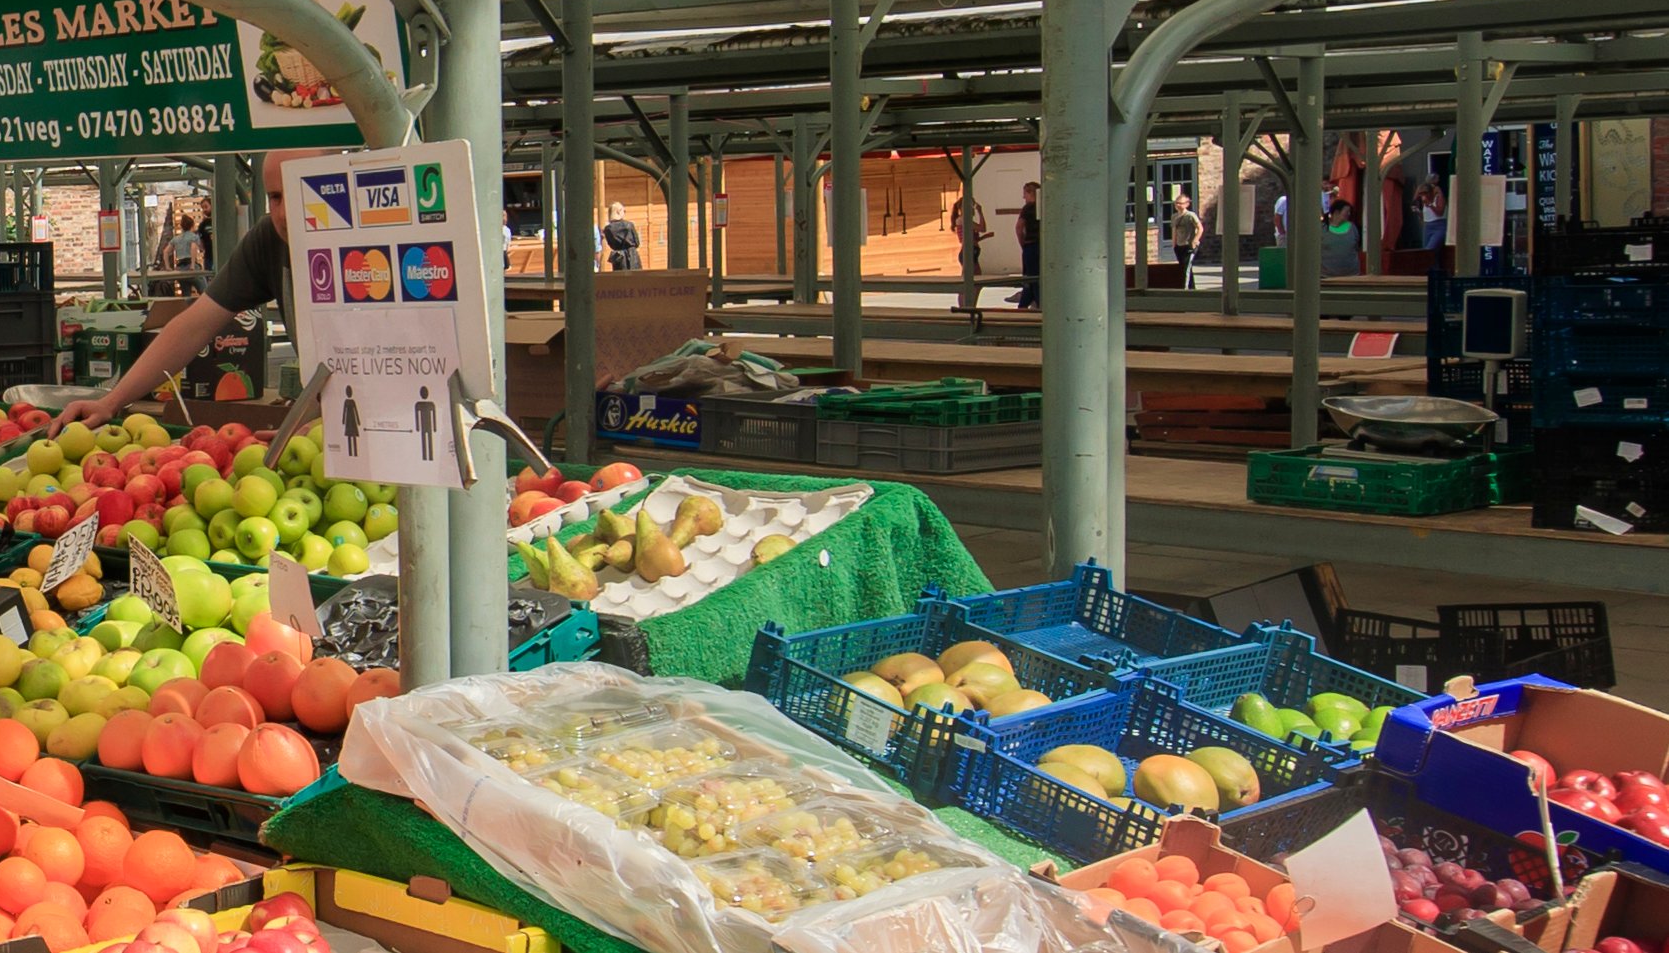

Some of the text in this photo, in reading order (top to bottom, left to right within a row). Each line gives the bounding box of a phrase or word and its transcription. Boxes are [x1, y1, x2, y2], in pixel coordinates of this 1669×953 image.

[43, 52, 129, 93] THURSDAY
[141, 44, 234, 86] SATURDAY
[77, 109, 143, 140] 07470
[149, 102, 235, 136] 308824
[1481, 140, 1494, 175] WATC
[320, 183, 346, 195] DELTA
[366, 186, 400, 208] VISA
[344, 267, 390, 283] MasterCard
[406, 265, 449, 280] Maestro
[638, 287, 667, 297] WITH
[669, 286, 696, 297] CARE
[376, 345, 381, 354] 2
[327, 357, 446, 375] SAVE LIVES NOW
[625, 409, 698, 434] Huskie
